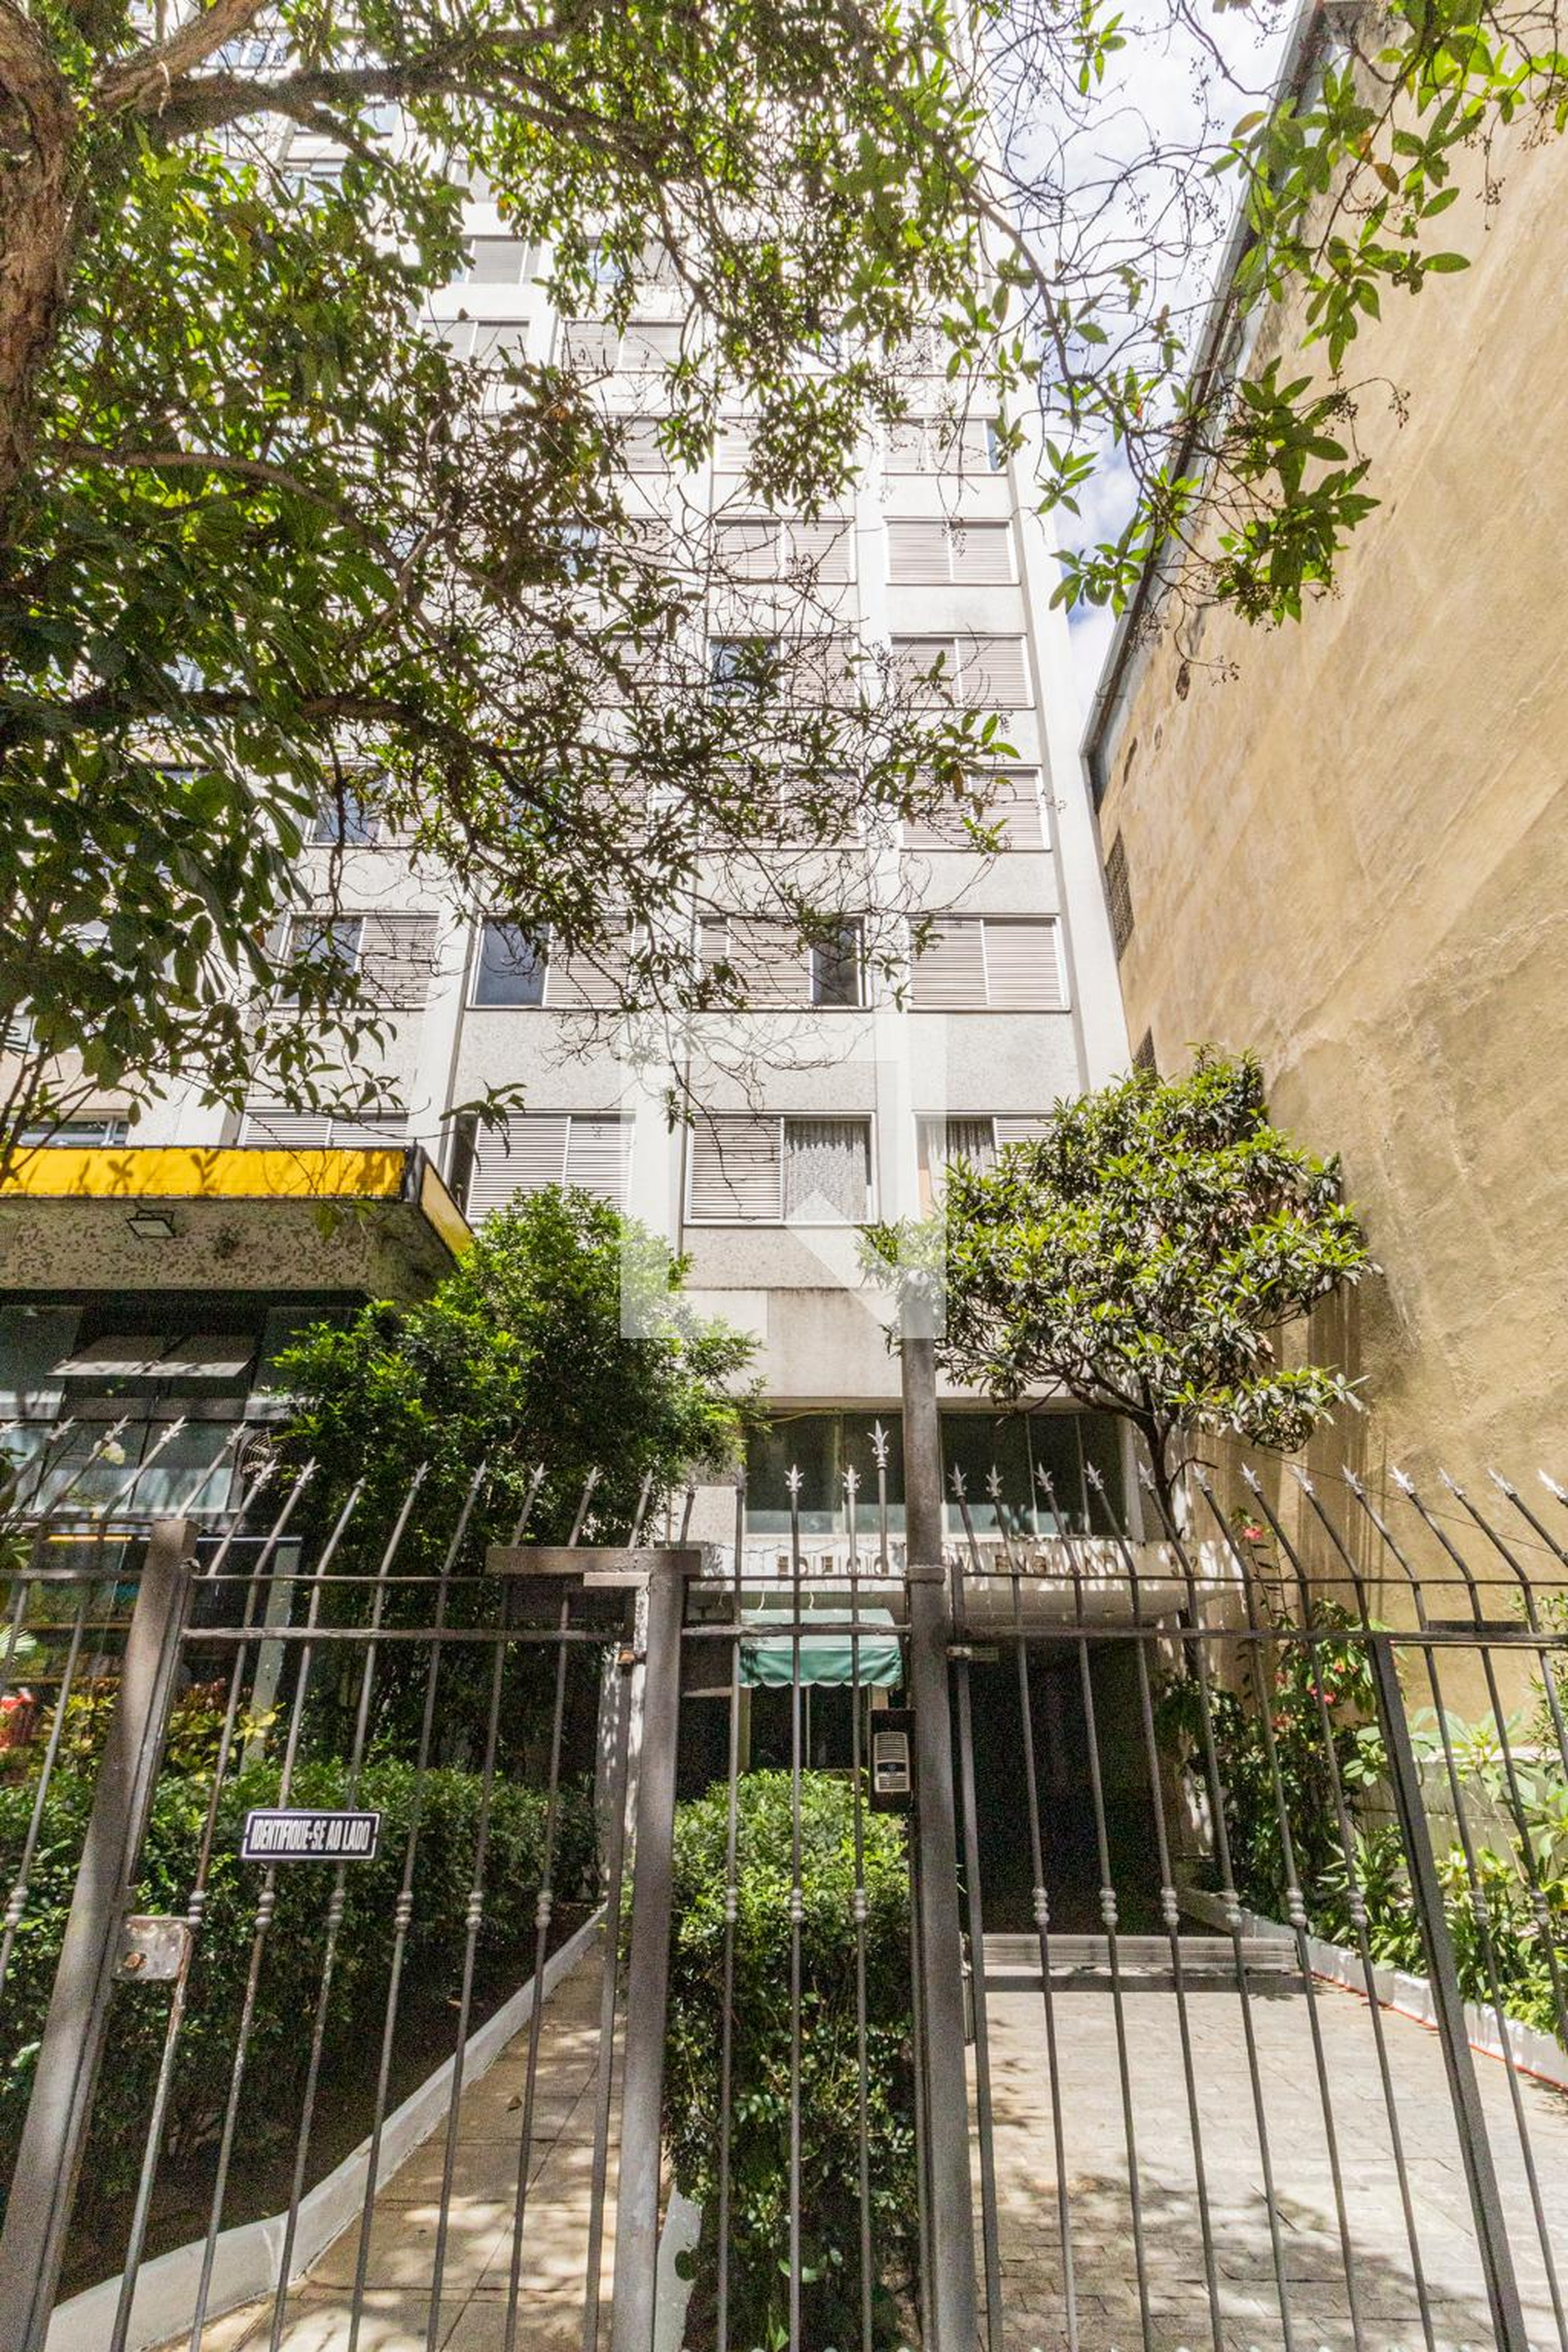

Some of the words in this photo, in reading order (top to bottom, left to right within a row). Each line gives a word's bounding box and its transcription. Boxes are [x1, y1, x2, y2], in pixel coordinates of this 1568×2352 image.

[250, 1819, 326, 1850] IDENTIFIQUE-SE
[325, 1820, 343, 1850] AO
[341, 1820, 371, 1851] LADO
